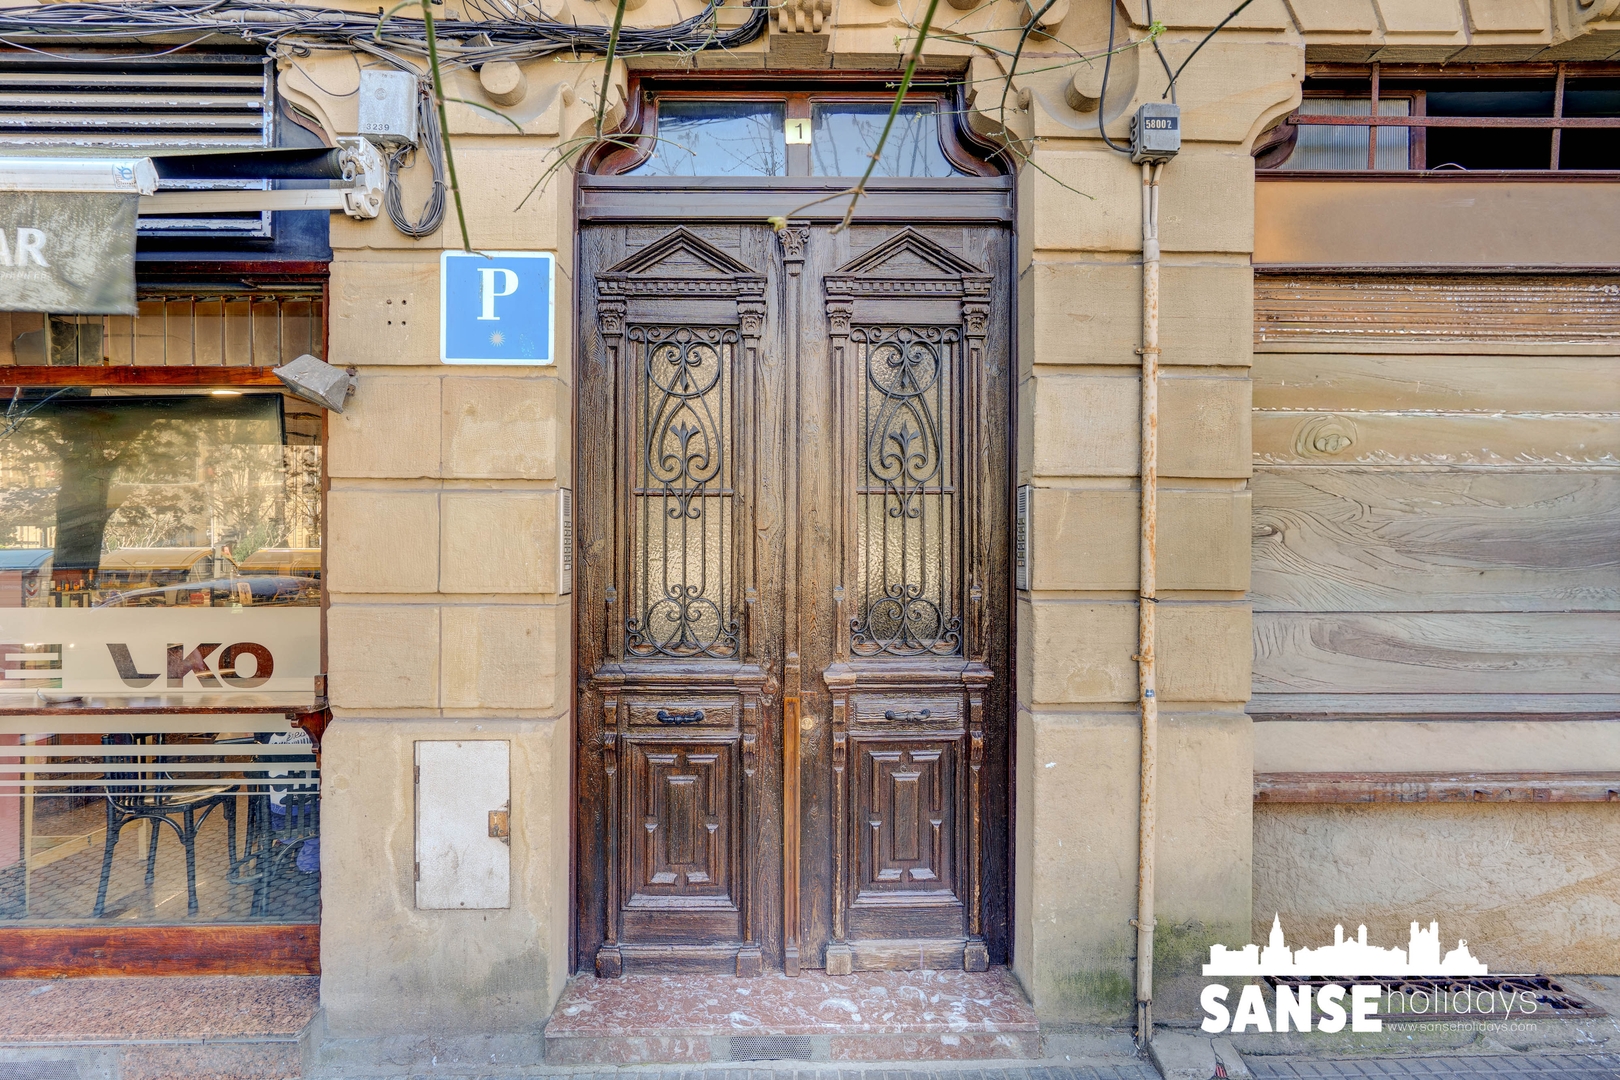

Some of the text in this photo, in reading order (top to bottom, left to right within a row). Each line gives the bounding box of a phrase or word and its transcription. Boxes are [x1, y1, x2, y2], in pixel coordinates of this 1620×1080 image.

[366, 123, 390, 131] 3239
[1145, 119, 1172, 129] 58002
[795, 123, 802, 139] 1
[477, 268, 519, 320] P
